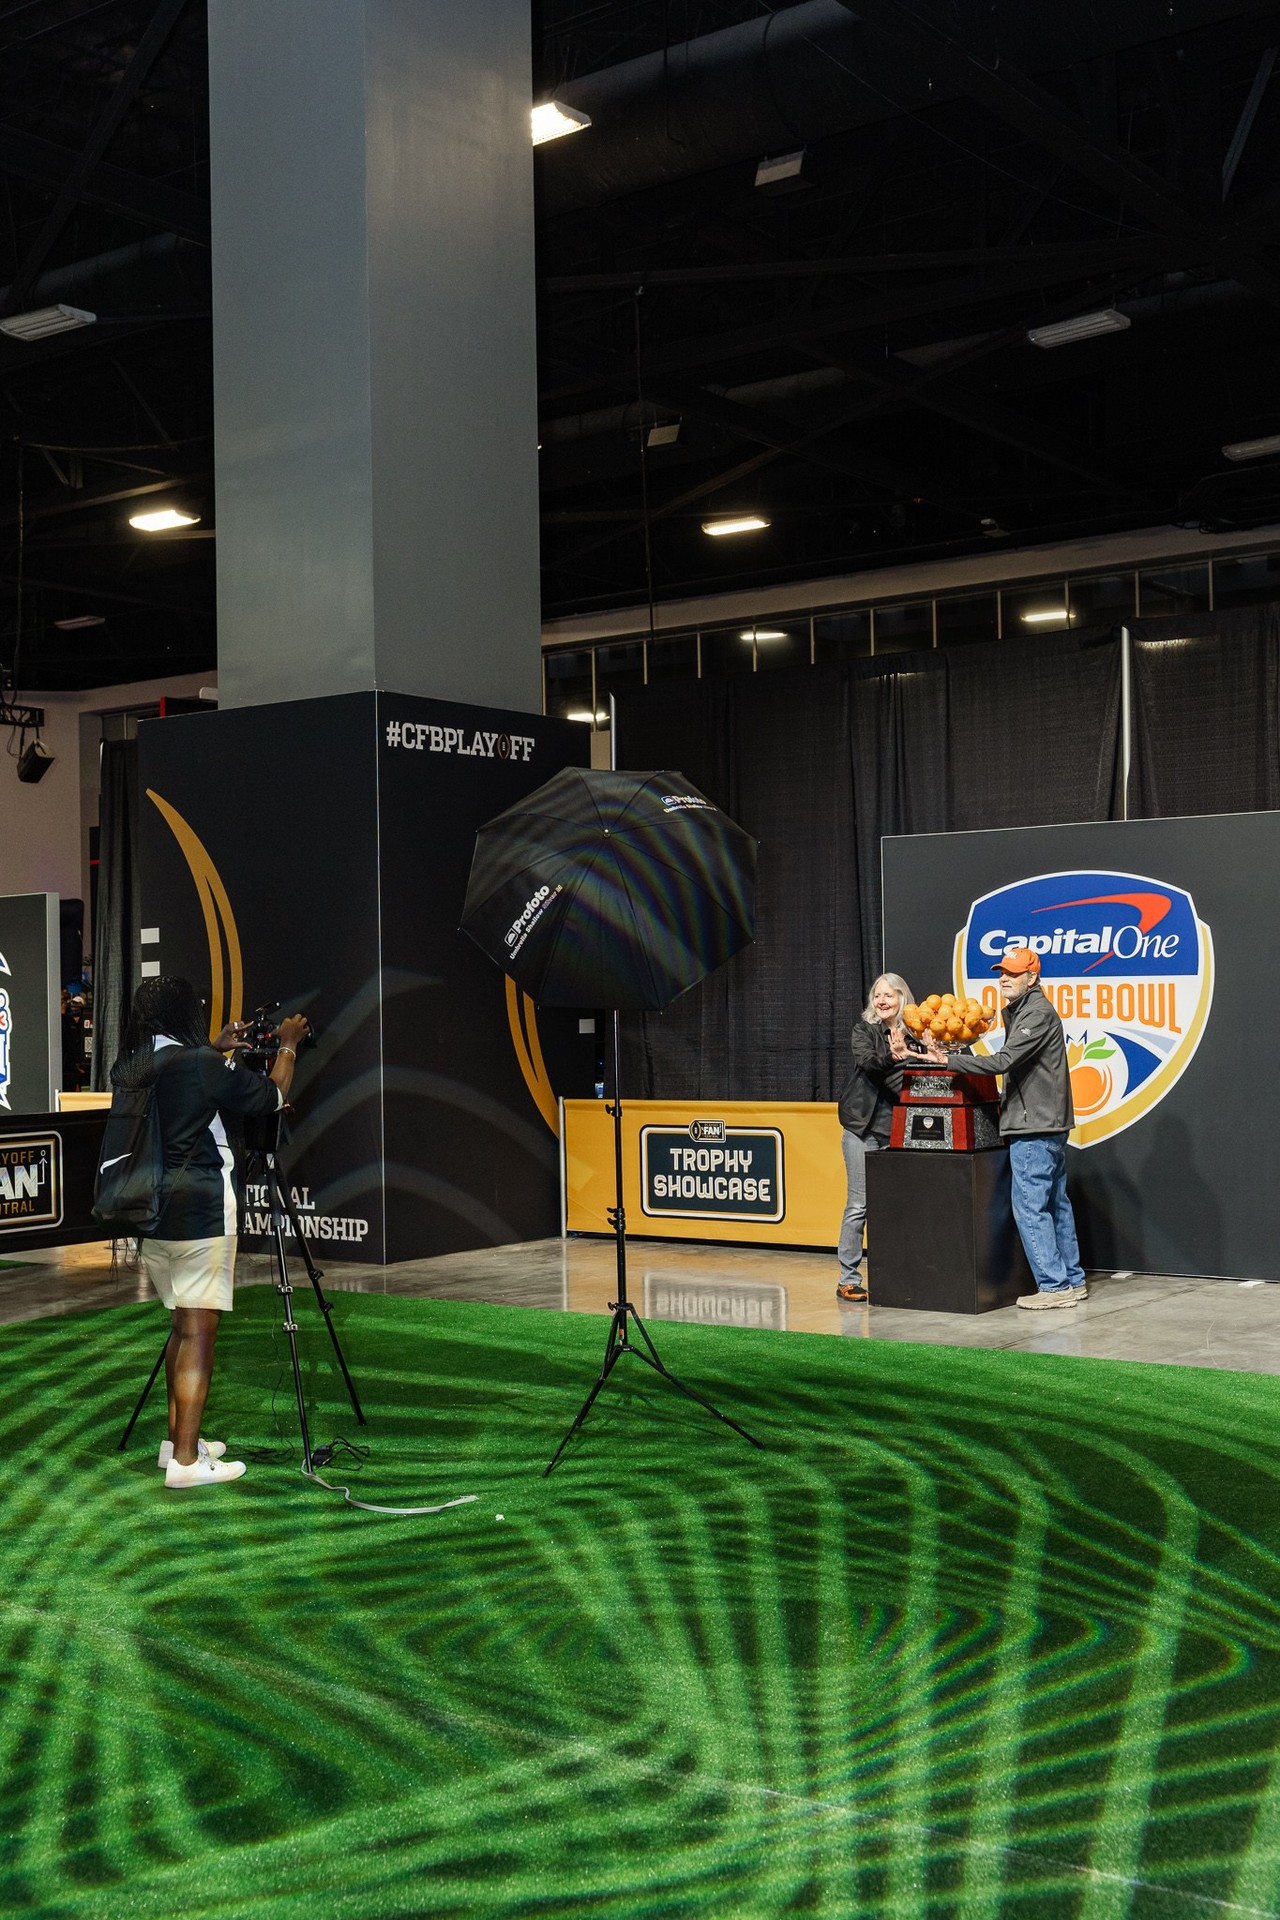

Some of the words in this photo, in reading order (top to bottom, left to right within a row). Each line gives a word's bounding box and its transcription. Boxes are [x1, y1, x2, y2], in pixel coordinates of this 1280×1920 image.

[512, 886, 550, 934] Profoto
[509, 933, 528, 960] Umbrella
[525, 908, 544, 933] Shallow
[979, 926, 1112, 956] Capital
[1113, 925, 1180, 959] One
[1096, 983, 1182, 1035] BOWL
[703, 1126, 720, 1136] FAN
[669, 1148, 753, 1174] TROPHY
[653, 1174, 771, 1203] SHOWCASE
[0, 1200, 35, 1215] TRAL
